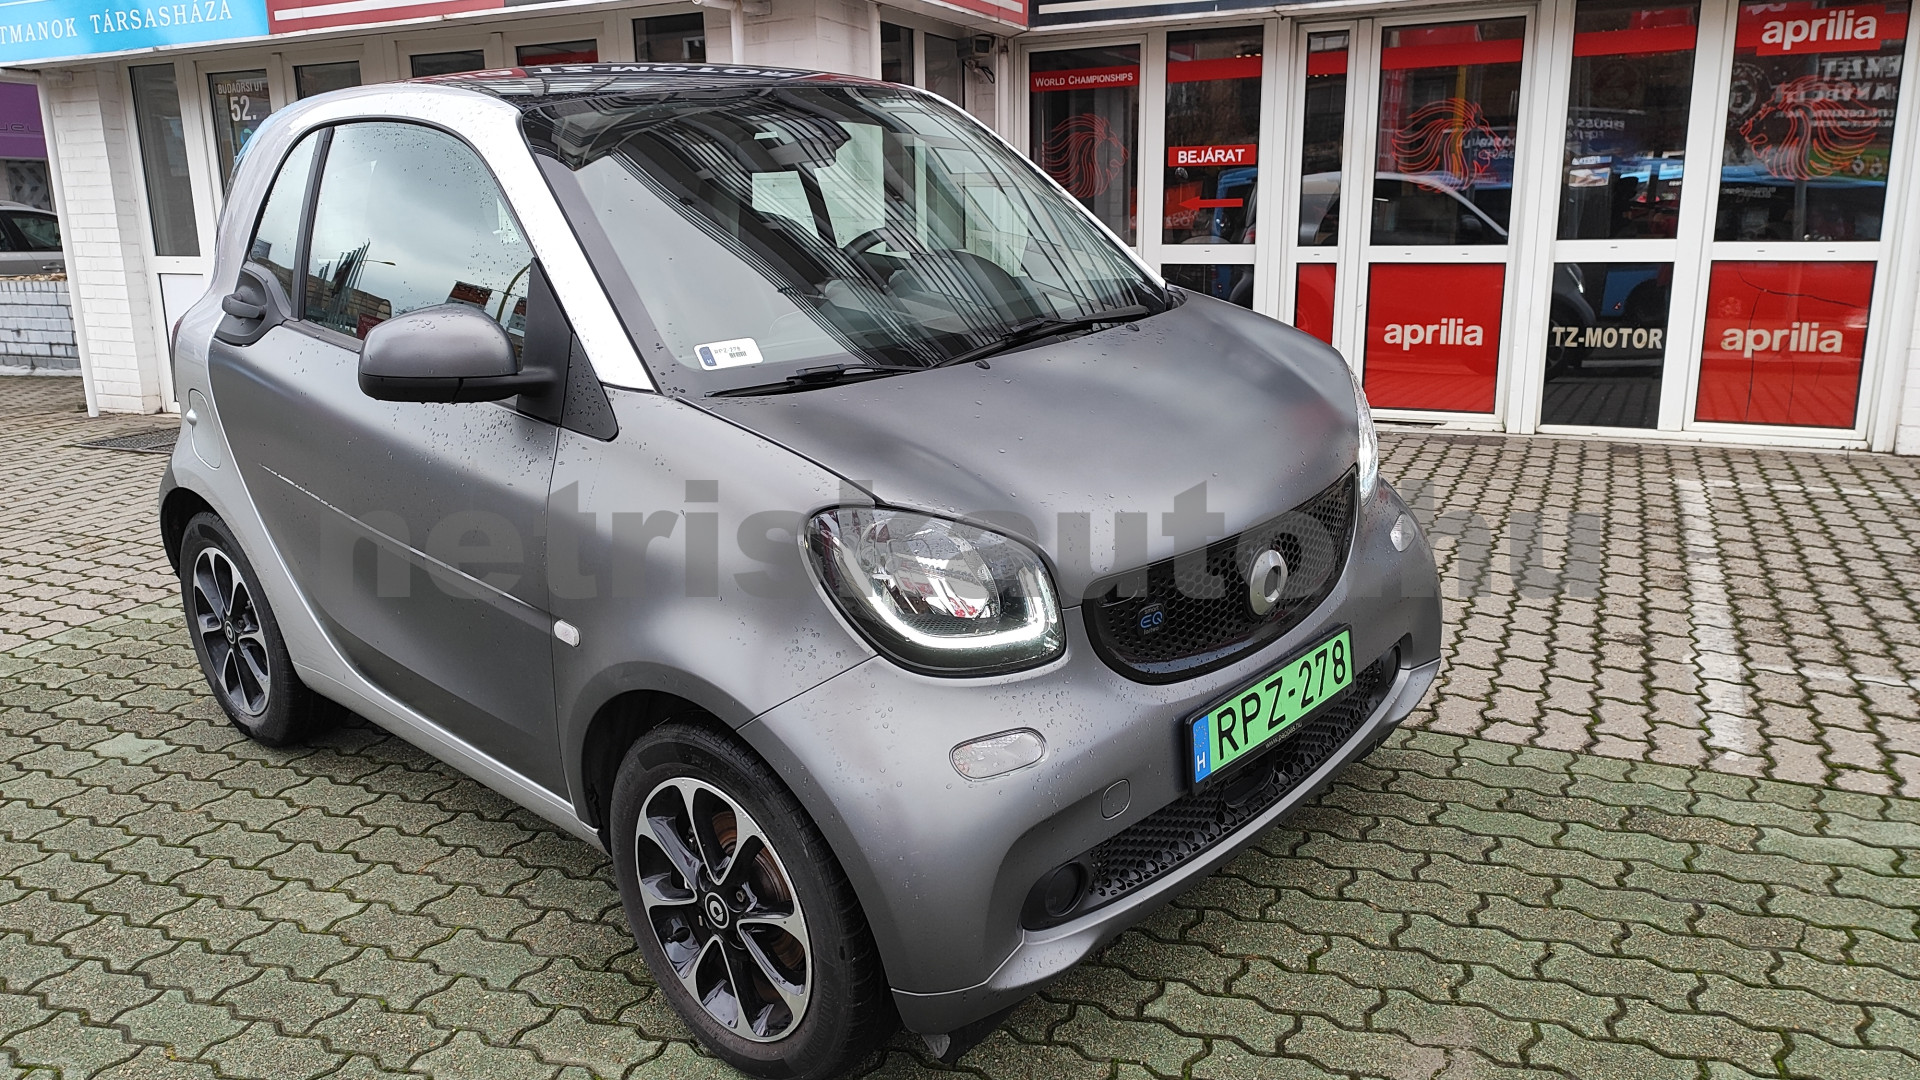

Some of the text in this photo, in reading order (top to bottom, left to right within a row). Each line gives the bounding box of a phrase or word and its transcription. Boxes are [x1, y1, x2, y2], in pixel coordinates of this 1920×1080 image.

[90, 0, 233, 34] TÁRSASHÁZA
[1761, 10, 1878, 50] aprilia
[1035, 72, 1133, 87] WORLD CHAMPIONSHIPS
[230, 95, 257, 121] 52.
[1177, 147, 1246, 164] BEJÁRAT
[1383, 318, 1484, 351] aprilia
[1552, 326, 1663, 350] TZ-MOTOR
[1720, 322, 1844, 359] aprilia
[1140, 611, 1163, 628] EQ
[1216, 639, 1347, 761] RPZ-278
[1196, 751, 1206, 772] H
